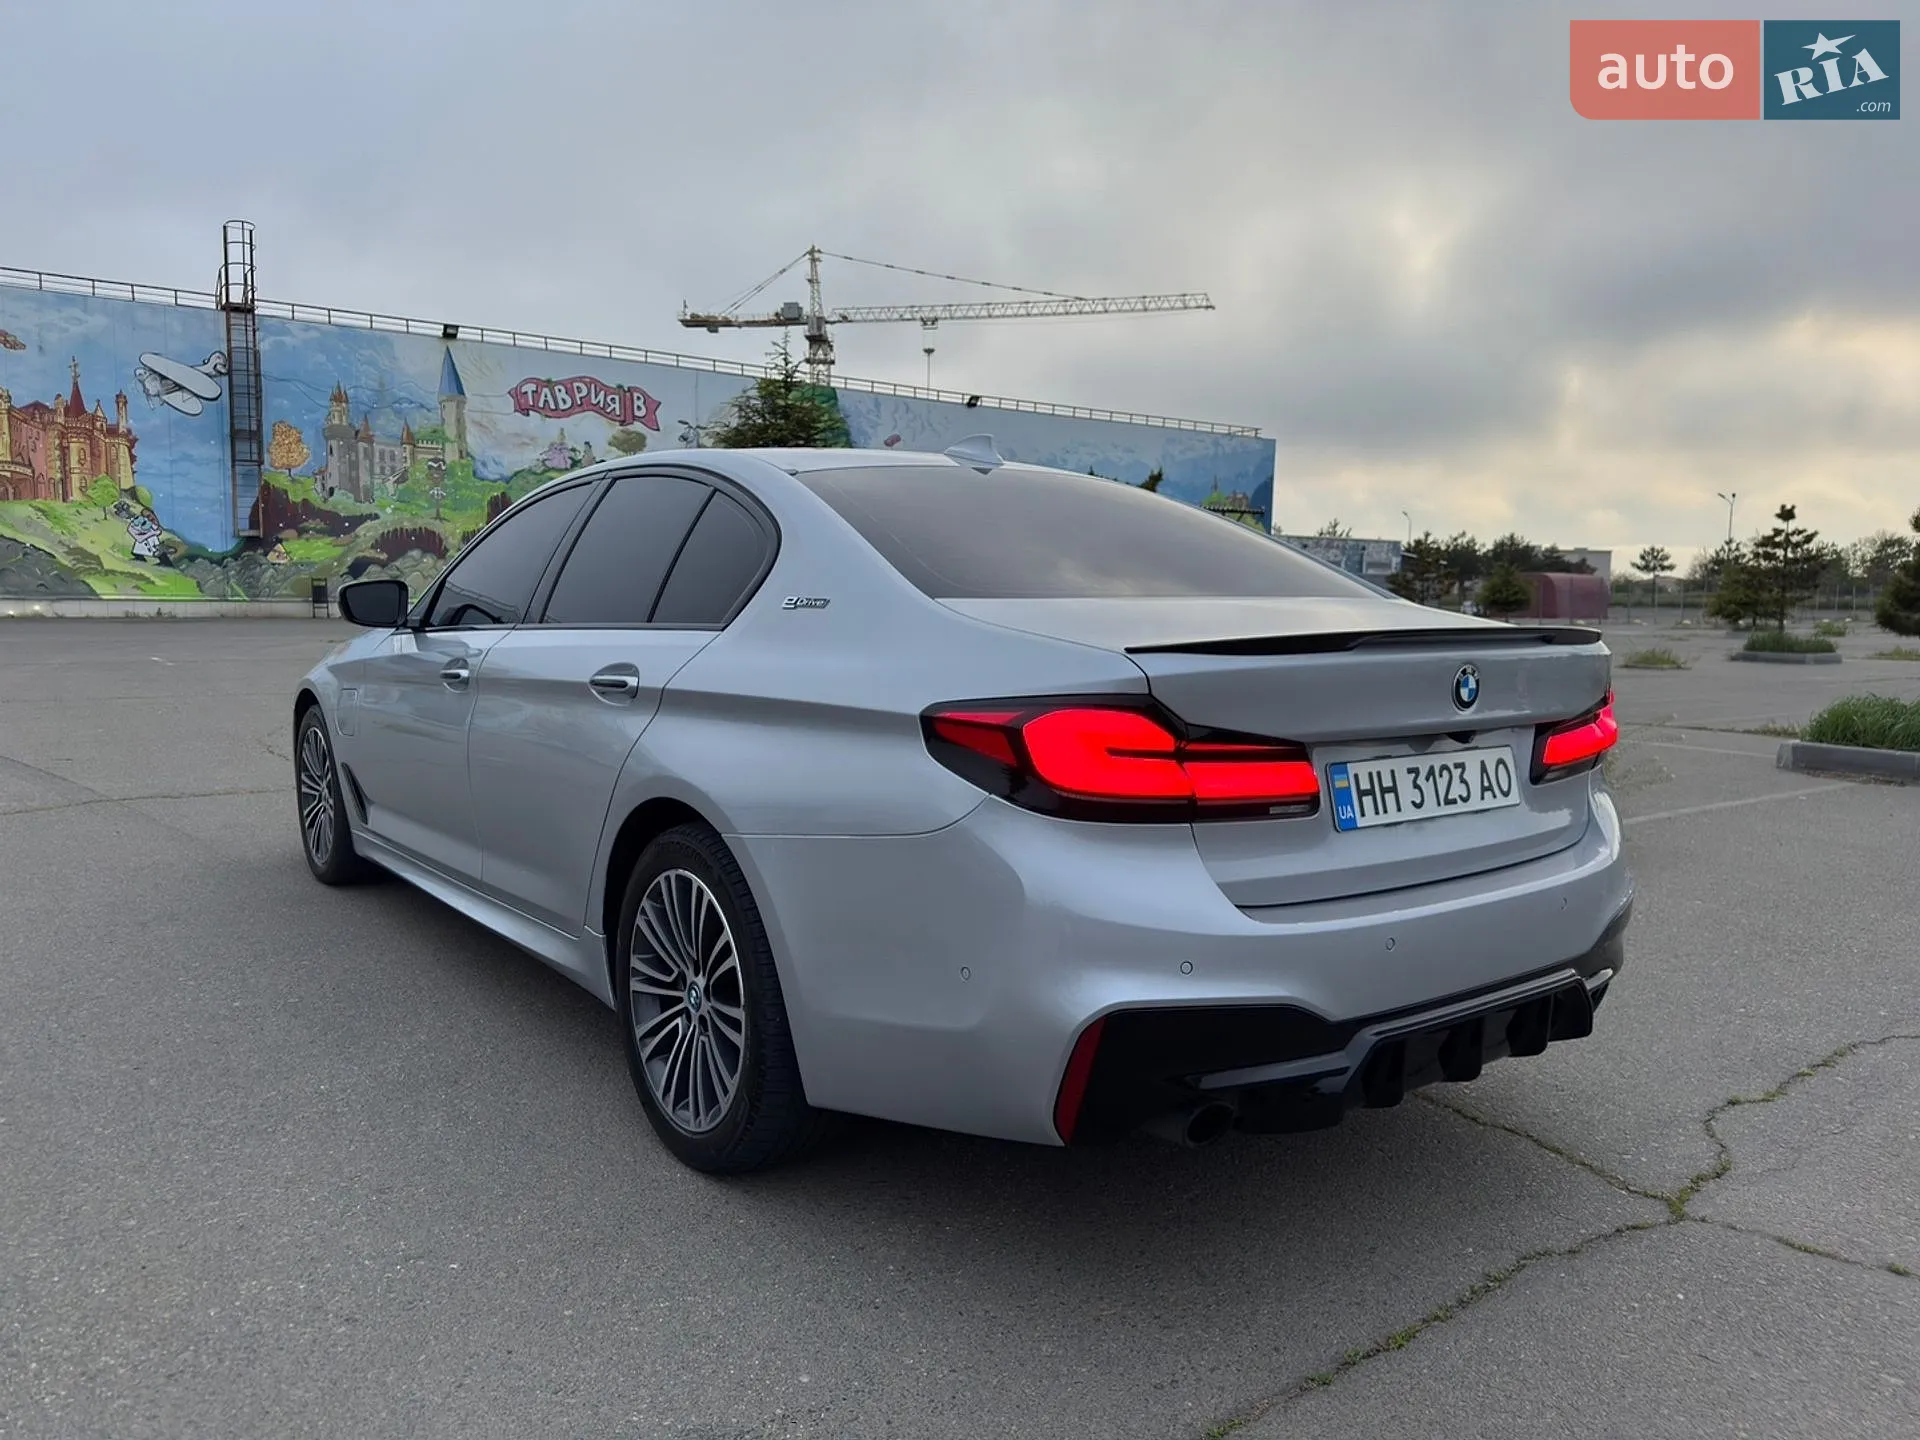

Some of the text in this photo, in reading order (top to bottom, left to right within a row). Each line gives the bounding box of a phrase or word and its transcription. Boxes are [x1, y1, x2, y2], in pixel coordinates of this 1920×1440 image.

[521, 383, 647, 417] ТАВРИЯ В
[1354, 769, 1401, 817] HH
[1406, 762, 1471, 809] 3123
[1338, 805, 1355, 820] UA
